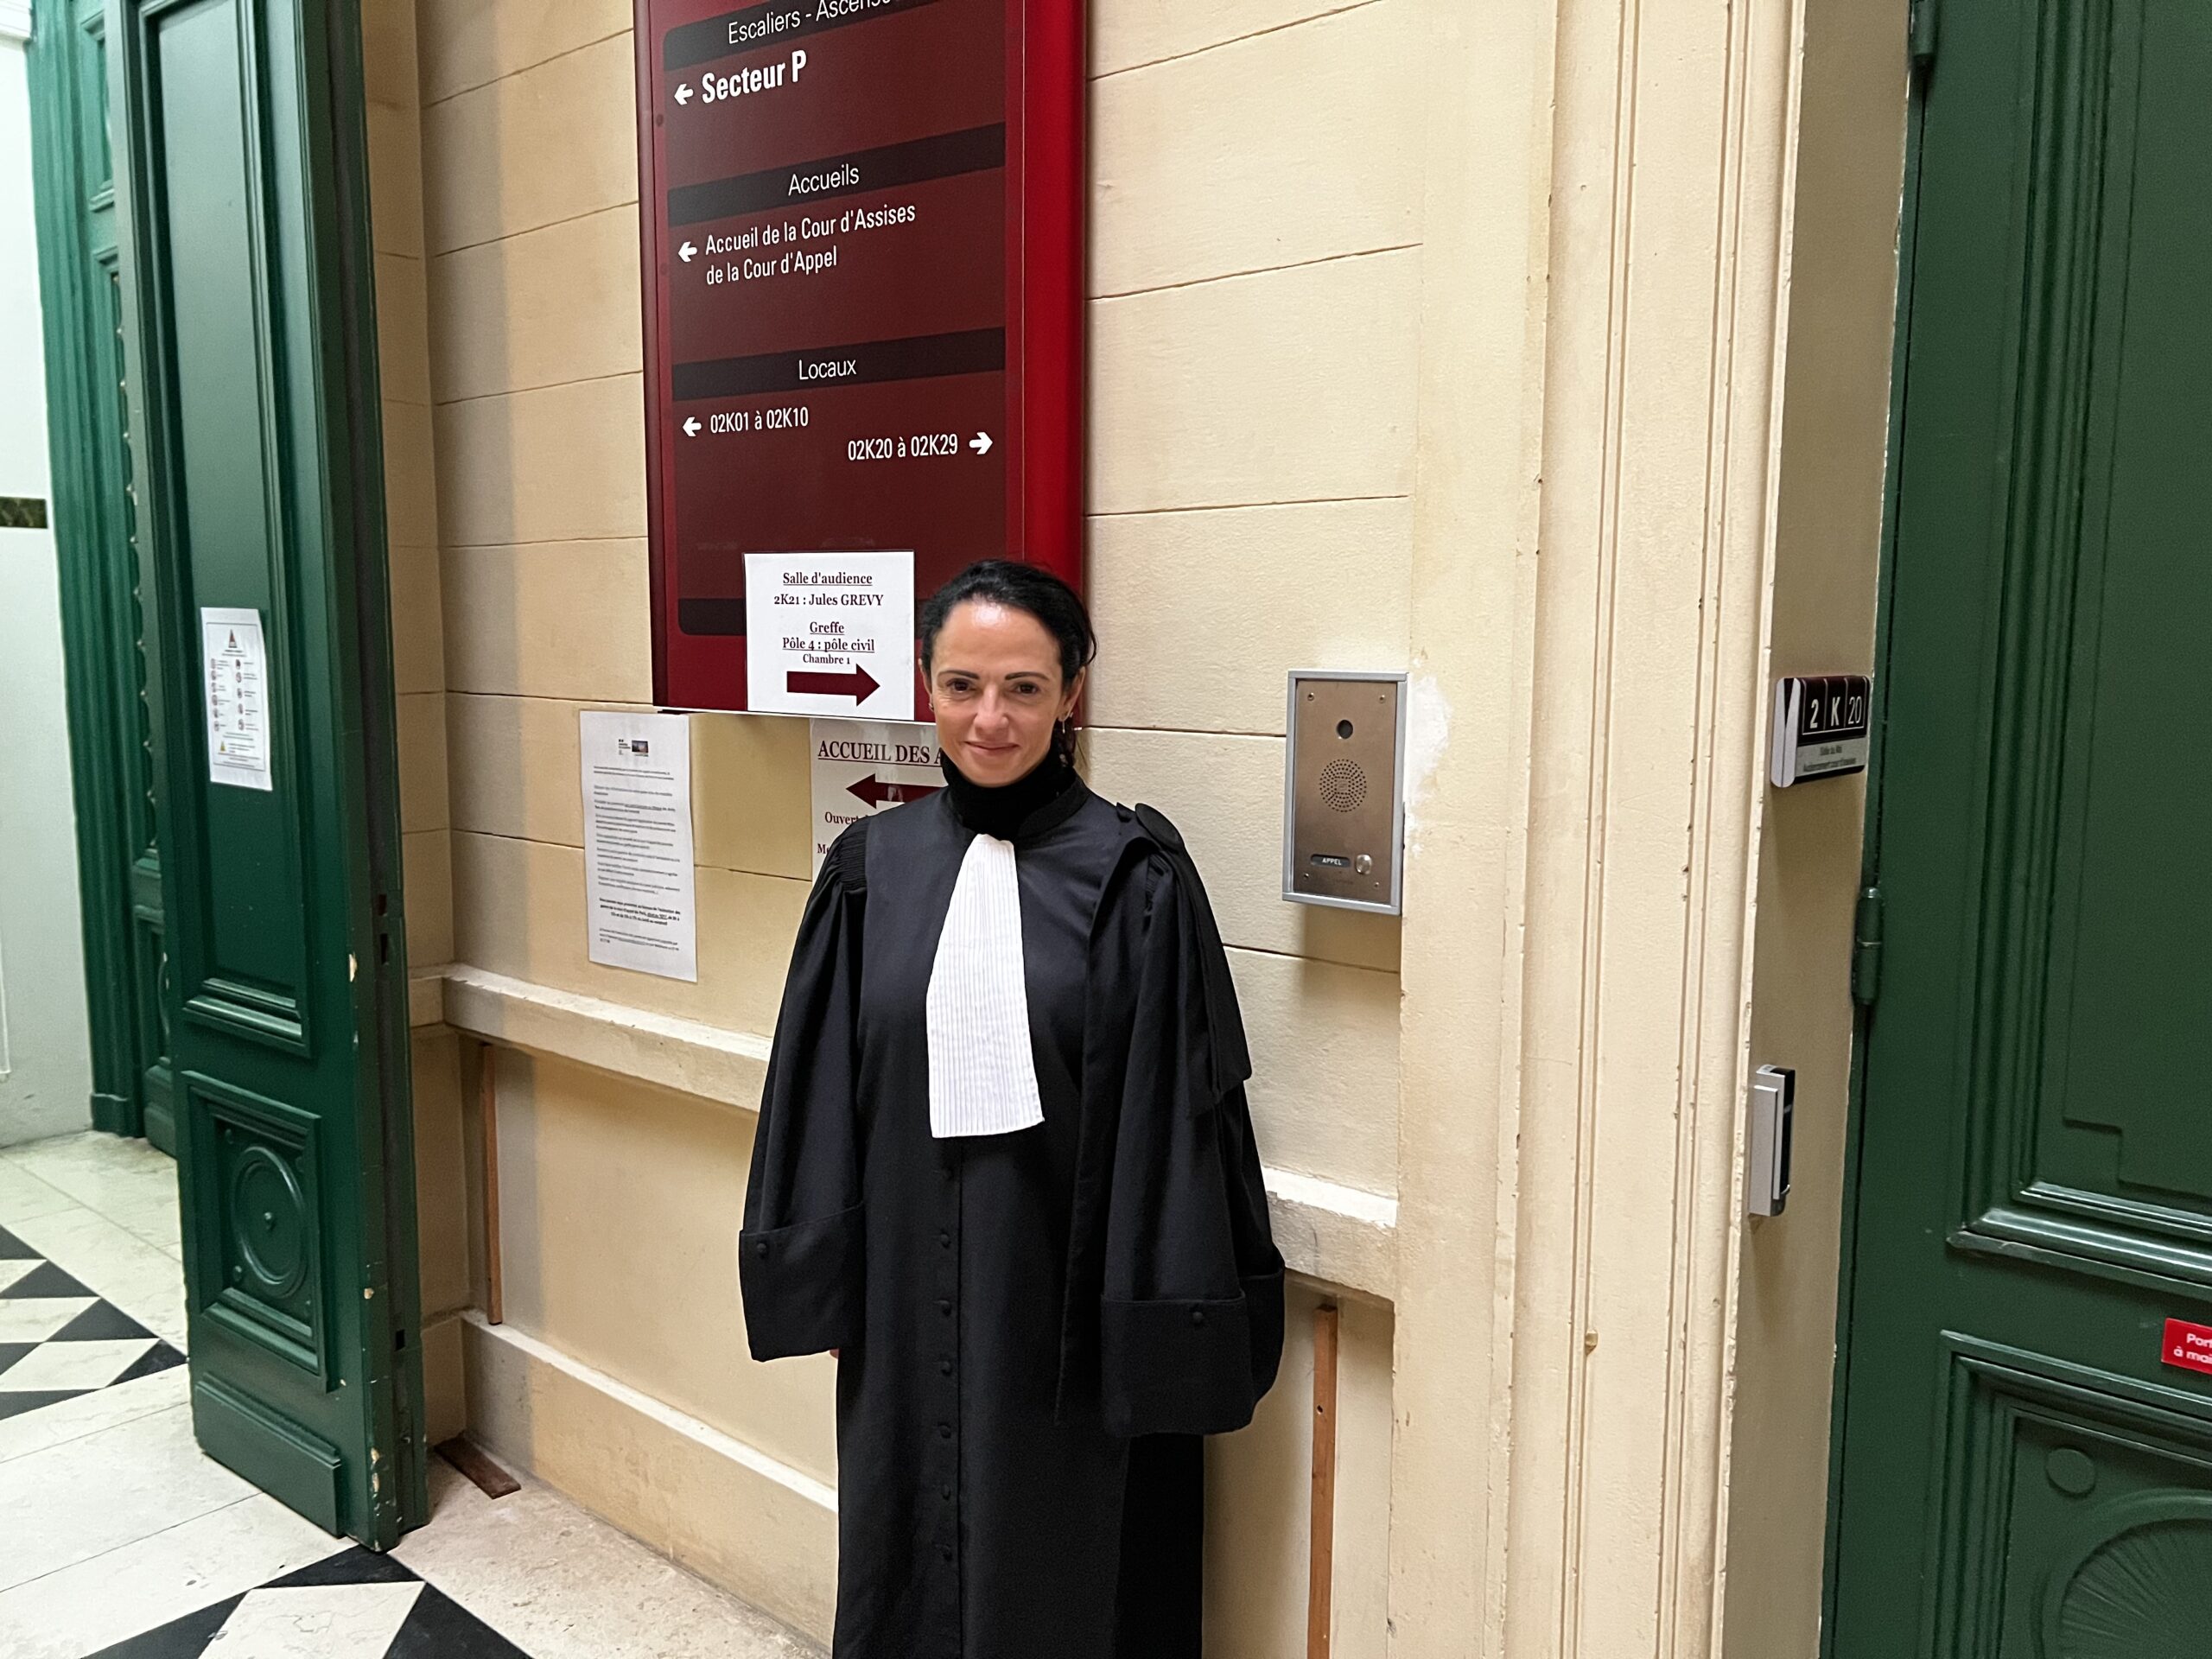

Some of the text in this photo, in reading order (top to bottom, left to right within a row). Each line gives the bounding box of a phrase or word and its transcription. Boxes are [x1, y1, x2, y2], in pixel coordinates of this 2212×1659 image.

[728, 10, 801, 44] Escaliers
[702, 49, 807, 104] Secteur P
[788, 163, 860, 196] Accueils
[705, 204, 916, 255] Accueil de la Cour d'Assises
[707, 245, 837, 285] de la Cour d'Appel
[798, 359, 857, 380] Locaux
[710, 406, 809, 434] 02K01 à 02K10
[848, 433, 958, 461] 02K20 à 02K29
[783, 572, 873, 584] Salle d'audience
[774, 594, 800, 605] 2K21
[809, 593, 838, 606] Jules
[841, 594, 884, 606] GREVY
[810, 621, 845, 633] Greffe
[782, 637, 805, 649] Pôle
[808, 639, 815, 651] 4
[824, 638, 849, 652] pôle
[851, 639, 874, 652] civil
[803, 653, 844, 664] Chambre
[1809, 696, 1863, 729] 2 K 20
[817, 741, 892, 761] ACCUEIL
[895, 745, 931, 764] DES
[2173, 1345, 2183, 1357] à
